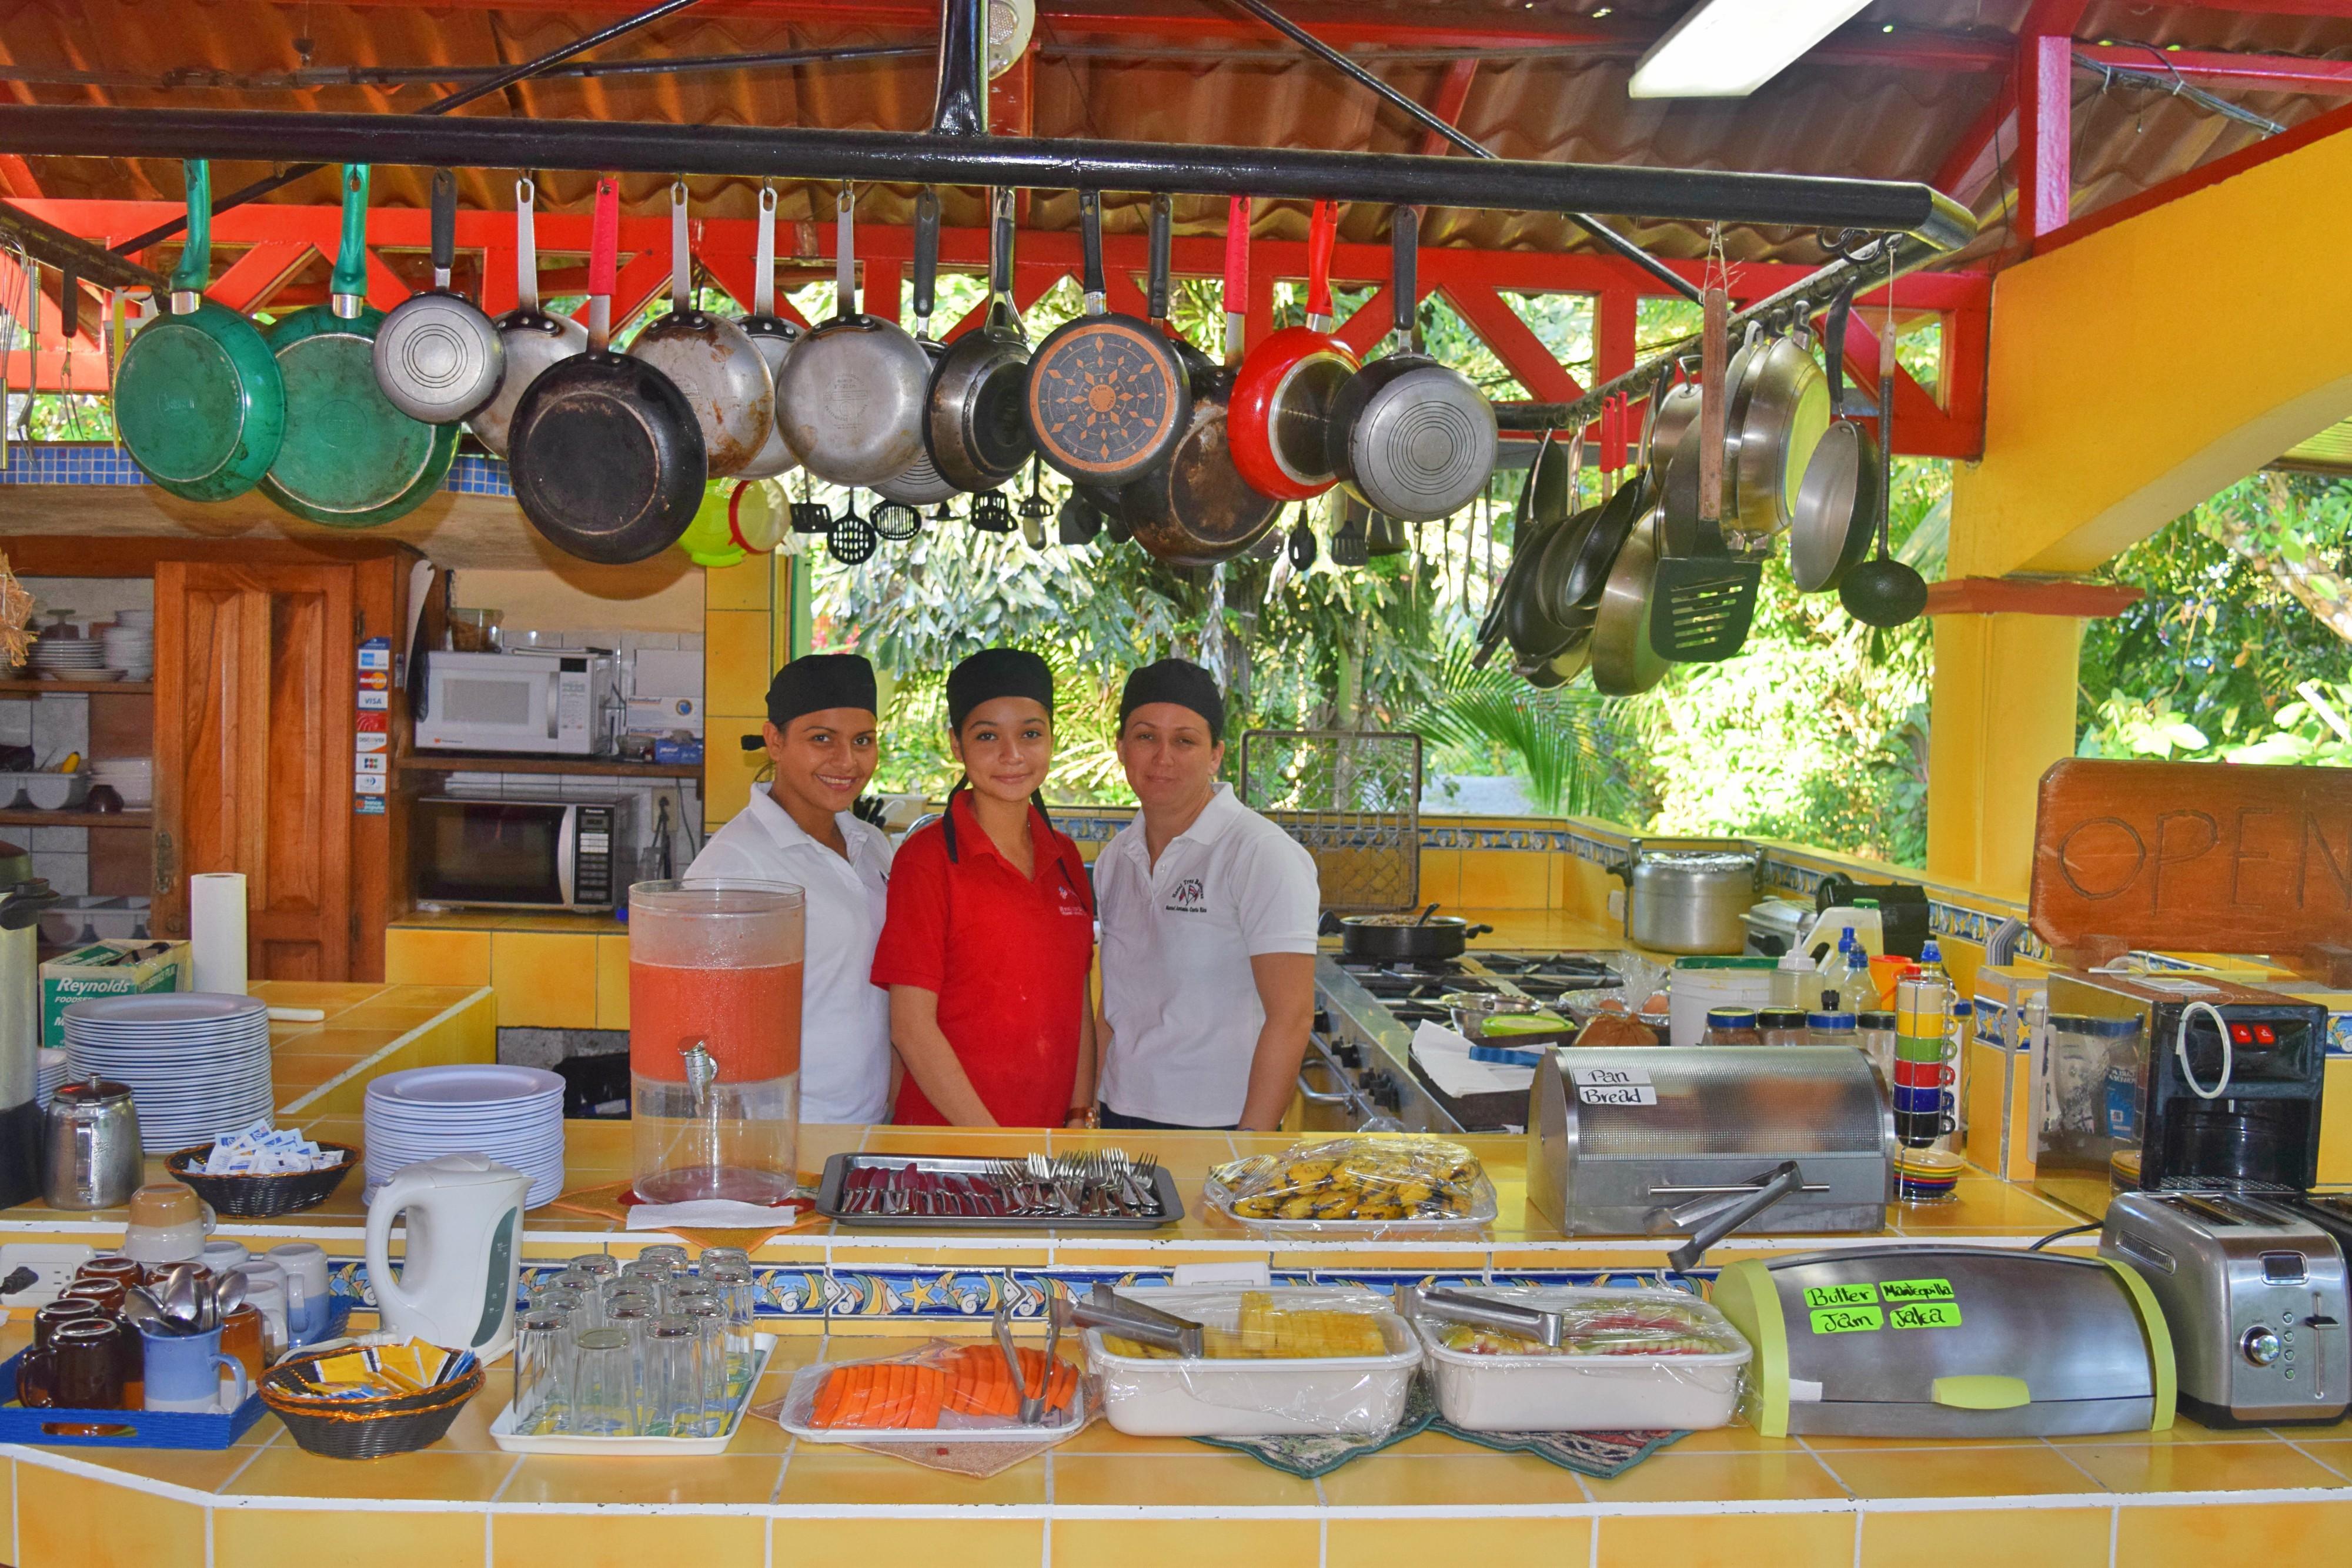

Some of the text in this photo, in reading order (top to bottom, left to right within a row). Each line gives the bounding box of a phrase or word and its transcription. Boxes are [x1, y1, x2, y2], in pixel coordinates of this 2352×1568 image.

[2057, 807, 2352, 918] OPEN
[56, 977, 131, 995] Reynolds
[1588, 1069, 1630, 1083] Pan
[1583, 1088, 1642, 1103] Bread
[1808, 1288, 1869, 1306] Butter
[1820, 1313, 1873, 1332] Jam
